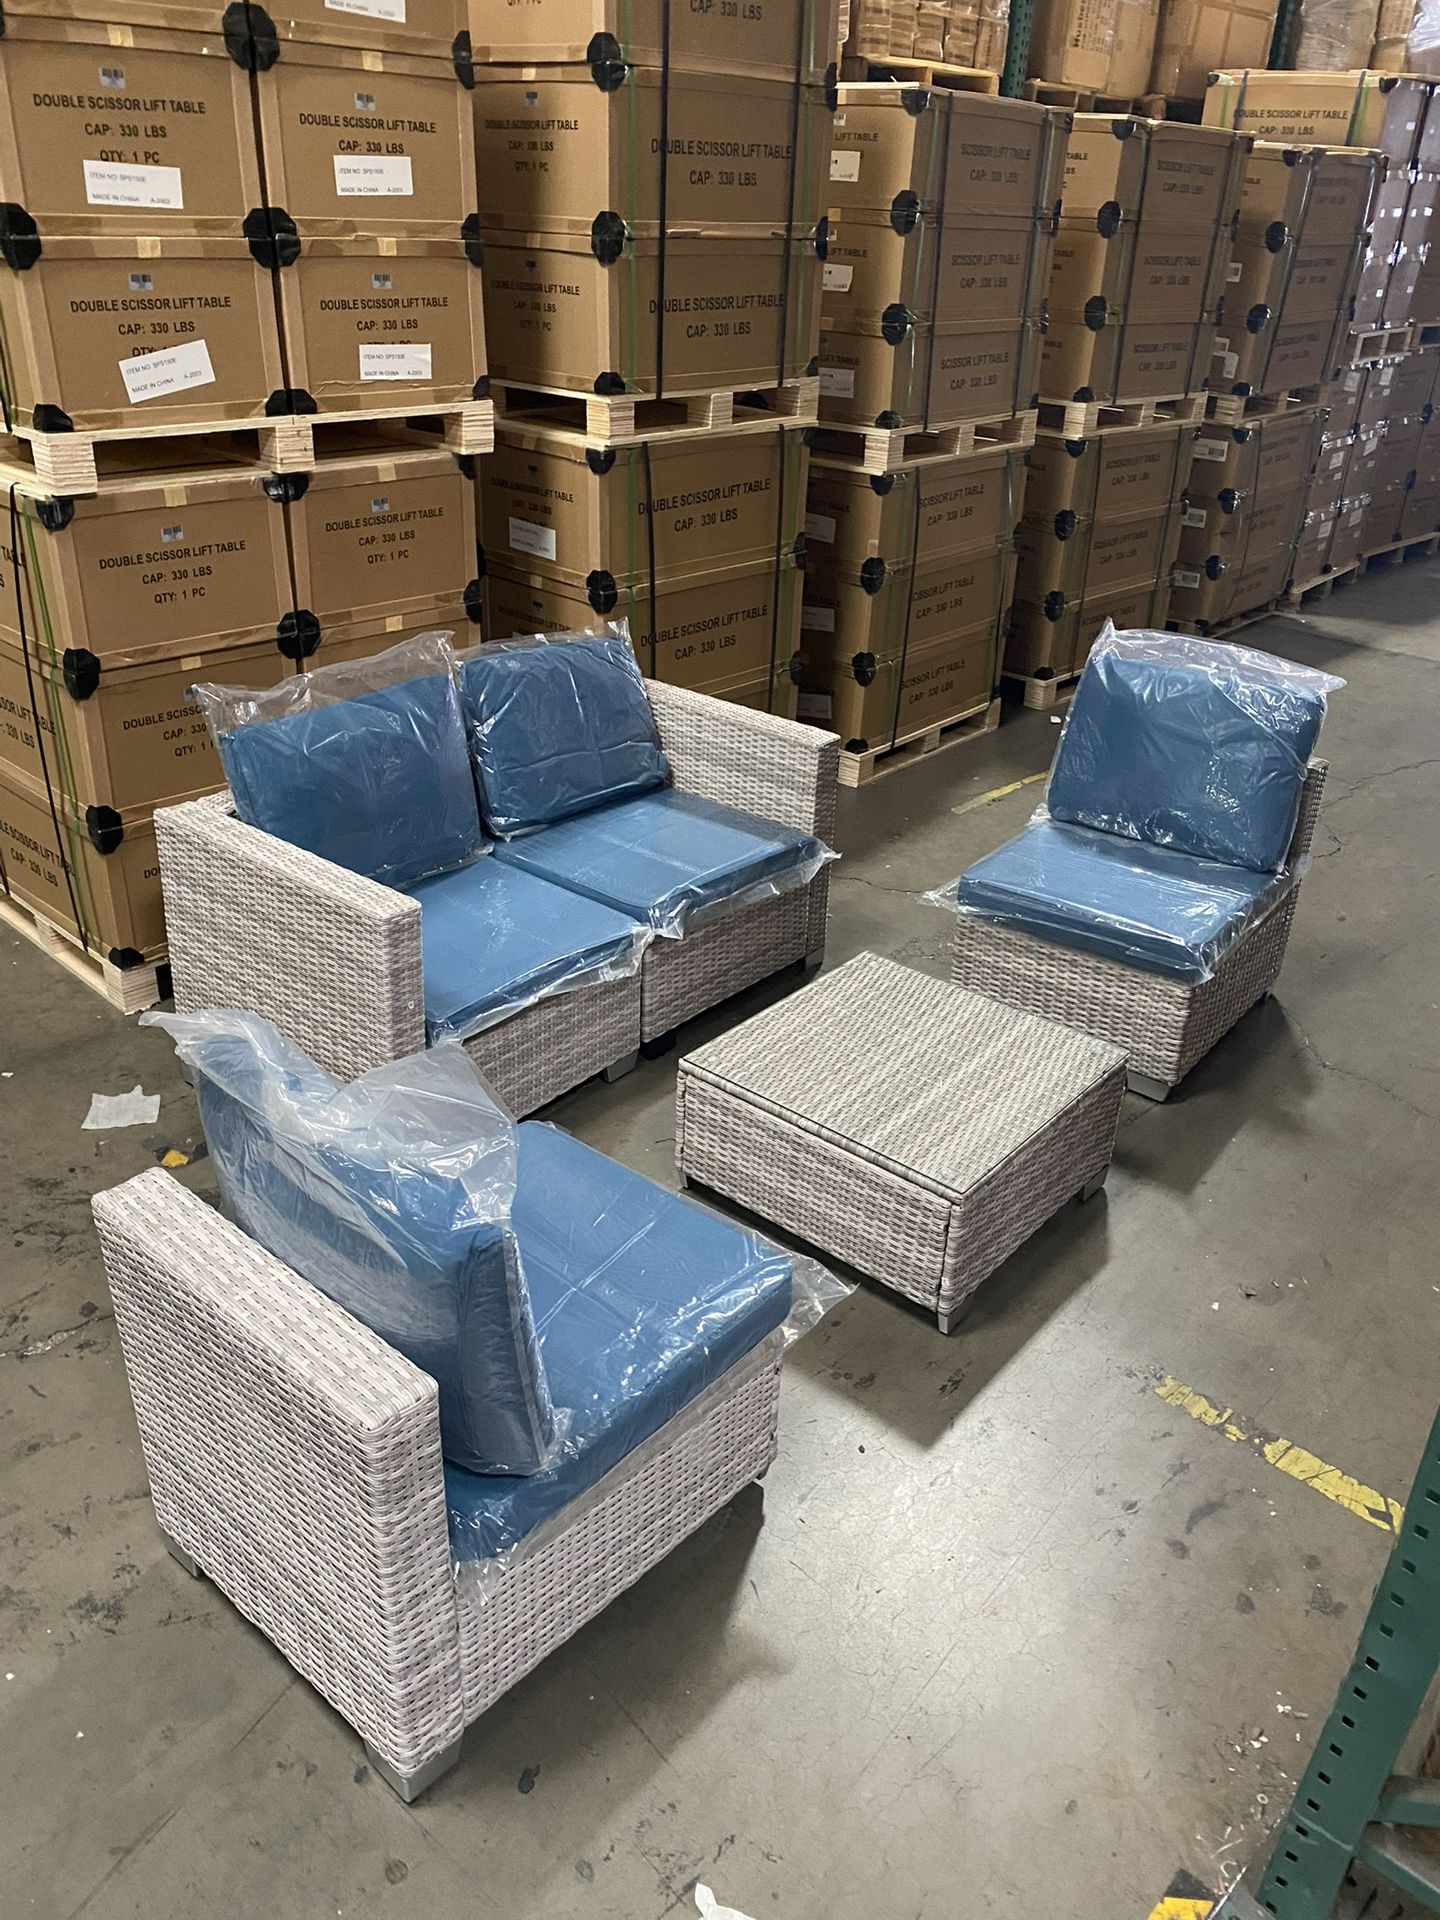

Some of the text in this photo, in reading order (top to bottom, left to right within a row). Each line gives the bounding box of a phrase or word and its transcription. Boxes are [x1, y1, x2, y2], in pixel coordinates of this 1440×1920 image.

[720, 1, 737, 17] 330
[742, 4, 762, 20] LBS
[33, 93, 205, 113] DOUBLE SCISSOR LIFT TABLE
[300, 113, 436, 133] DOUBLE SCISSOR LIFT TABLE
[1235, 110, 1348, 120] OUBLE SCISSOR LIFT TABLE
[85, 124, 167, 137] CAP: 330 LBS
[485, 120, 578, 130] DOUBLE SCISSOR LIFT TABLE
[850, 133, 878, 141] TABLE
[339, 140, 404, 153] CAP: 330 LBS
[652, 138, 791, 160] DUBLE SCISSOR LIFT TABLE
[100, 150, 159, 163] QTY: 1 PC
[1066, 152, 1088, 160] TABLE
[689, 171, 756, 186] CAP: 330 LBS
[491, 280, 579, 295] DOUBLE SCISSOR LIFT TABLE
[70, 297, 231, 312] DOUBLE SCISSOR LIFT TABLE
[320, 297, 448, 310] DOUBLE SCISSOR LIFT TABLE
[650, 295, 784, 313] DUBLE SCISSOR LIFT TABLE
[118, 321, 195, 335] CAP: 330 LBS
[357, 319, 418, 331] CAP: 330 LBS
[687, 322, 751, 338] CAP: 330 LBS
[941, 353, 1009, 369] SCISSOR LIFT TABLE
[554, 491, 574, 503] TABLE
[639, 478, 770, 515] DUBLE SCISSOR LIFT TABLE
[326, 507, 443, 532] DOUBLE SCISSOR LIFT TABLE
[674, 508, 737, 532] CAP: 330 LBS
[359, 530, 415, 547] CAP: 330 LBS
[99, 540, 246, 570] DOUBLE SCISSOR LIFT TABLE
[368, 550, 409, 565] QTY: 1 PC
[142, 566, 212, 586] CAP: 330 LBS
[154, 587, 206, 605] QTY: 1 PC
[681, 616, 720, 637] SCISSOR
[722, 611, 740, 627] LIFT
[741, 604, 768, 622] TABLE
[675, 635, 736, 660] CAP: 330 LBS
[123, 713, 165, 730] DOUBLE
[163, 722, 207, 740] CAP: 330
[174, 744, 196, 756] QTY:
[201, 742, 206, 750] 1
[42, 868, 58, 888] LBS
